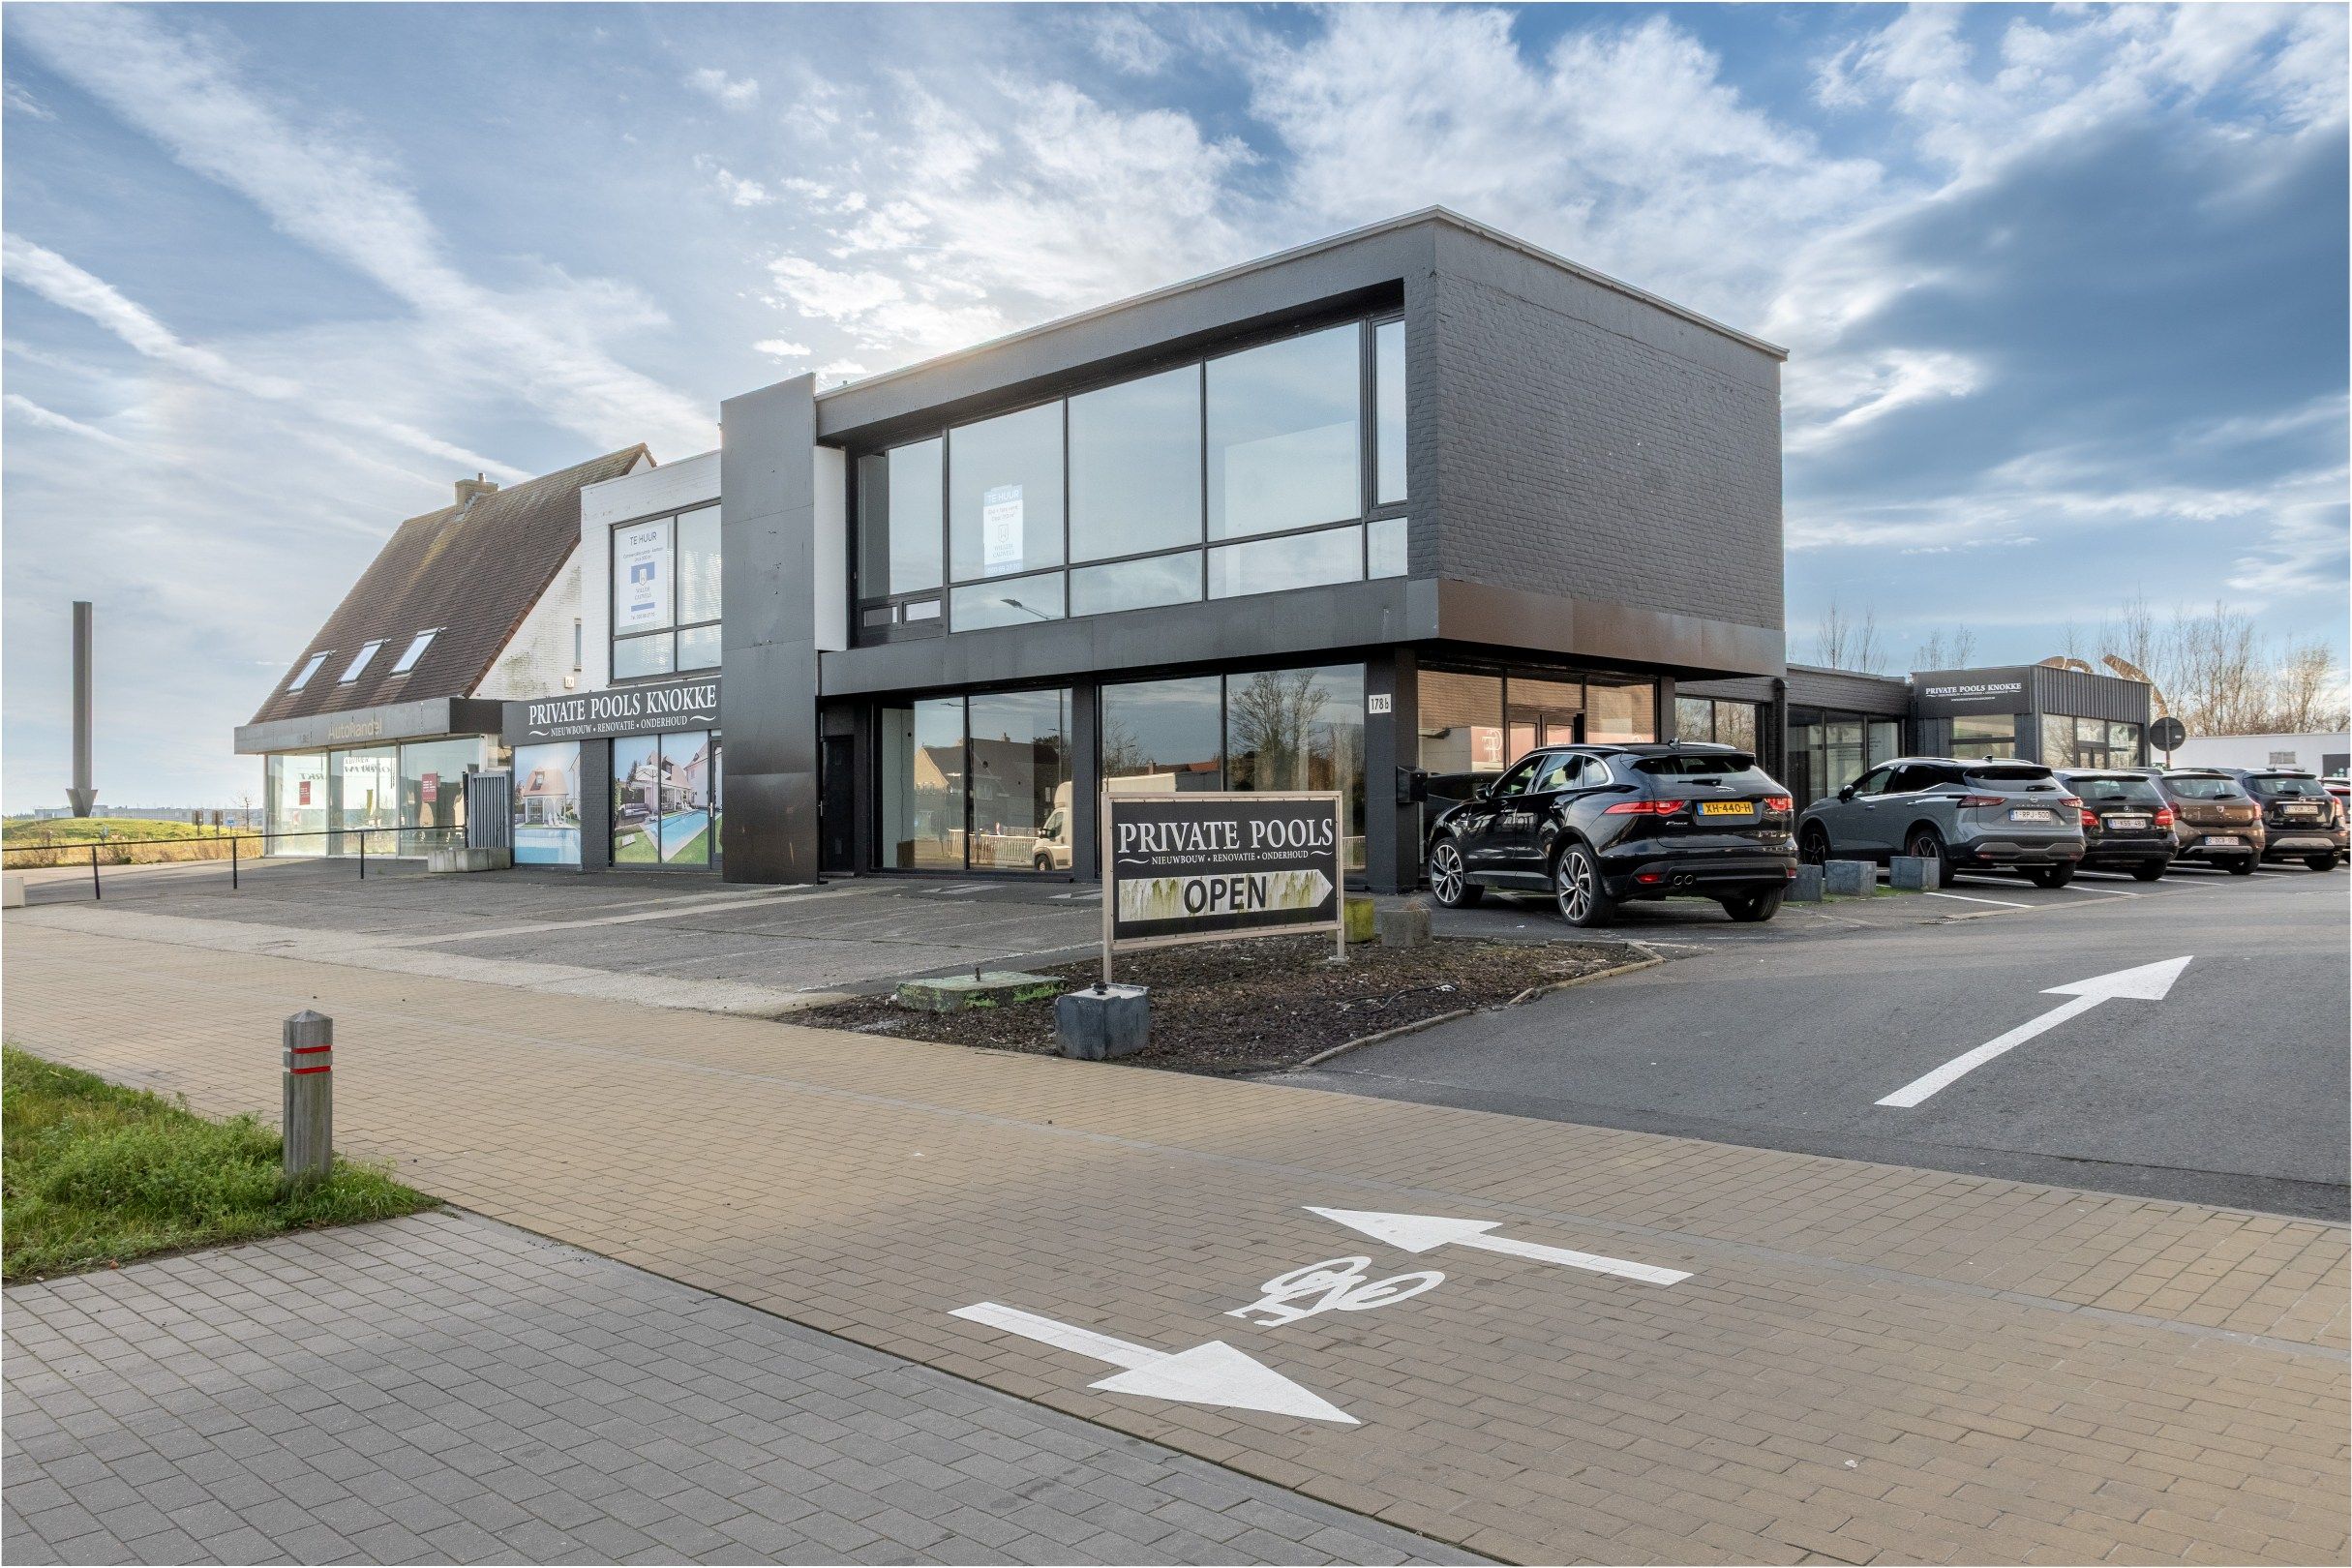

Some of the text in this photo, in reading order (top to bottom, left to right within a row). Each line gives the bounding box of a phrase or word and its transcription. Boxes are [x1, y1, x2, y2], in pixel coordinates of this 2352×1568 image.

[987, 490, 1019, 504] TE HUUR
[629, 531, 657, 546] TE HUUR
[1925, 686, 1957, 695] PRIVATE
[1959, 684, 1986, 693] POOLS
[1988, 682, 2022, 691] KNOKKE
[528, 685, 717, 726] PRIVATE POOLS KNOKKE
[1371, 697, 1390, 710] 178b
[551, 715, 688, 738] NIEUWBOUW RENOVATIE ONDERHOUD
[1705, 803, 1752, 814] XH-440-H
[2014, 810, 2050, 819] 1-RPJ-500
[1117, 818, 1334, 854] PRIVATE POOLS
[1152, 850, 1309, 865] NIEUWBOUW RENOVATIE ONDERHOUD
[1183, 875, 1267, 914] OPEN
